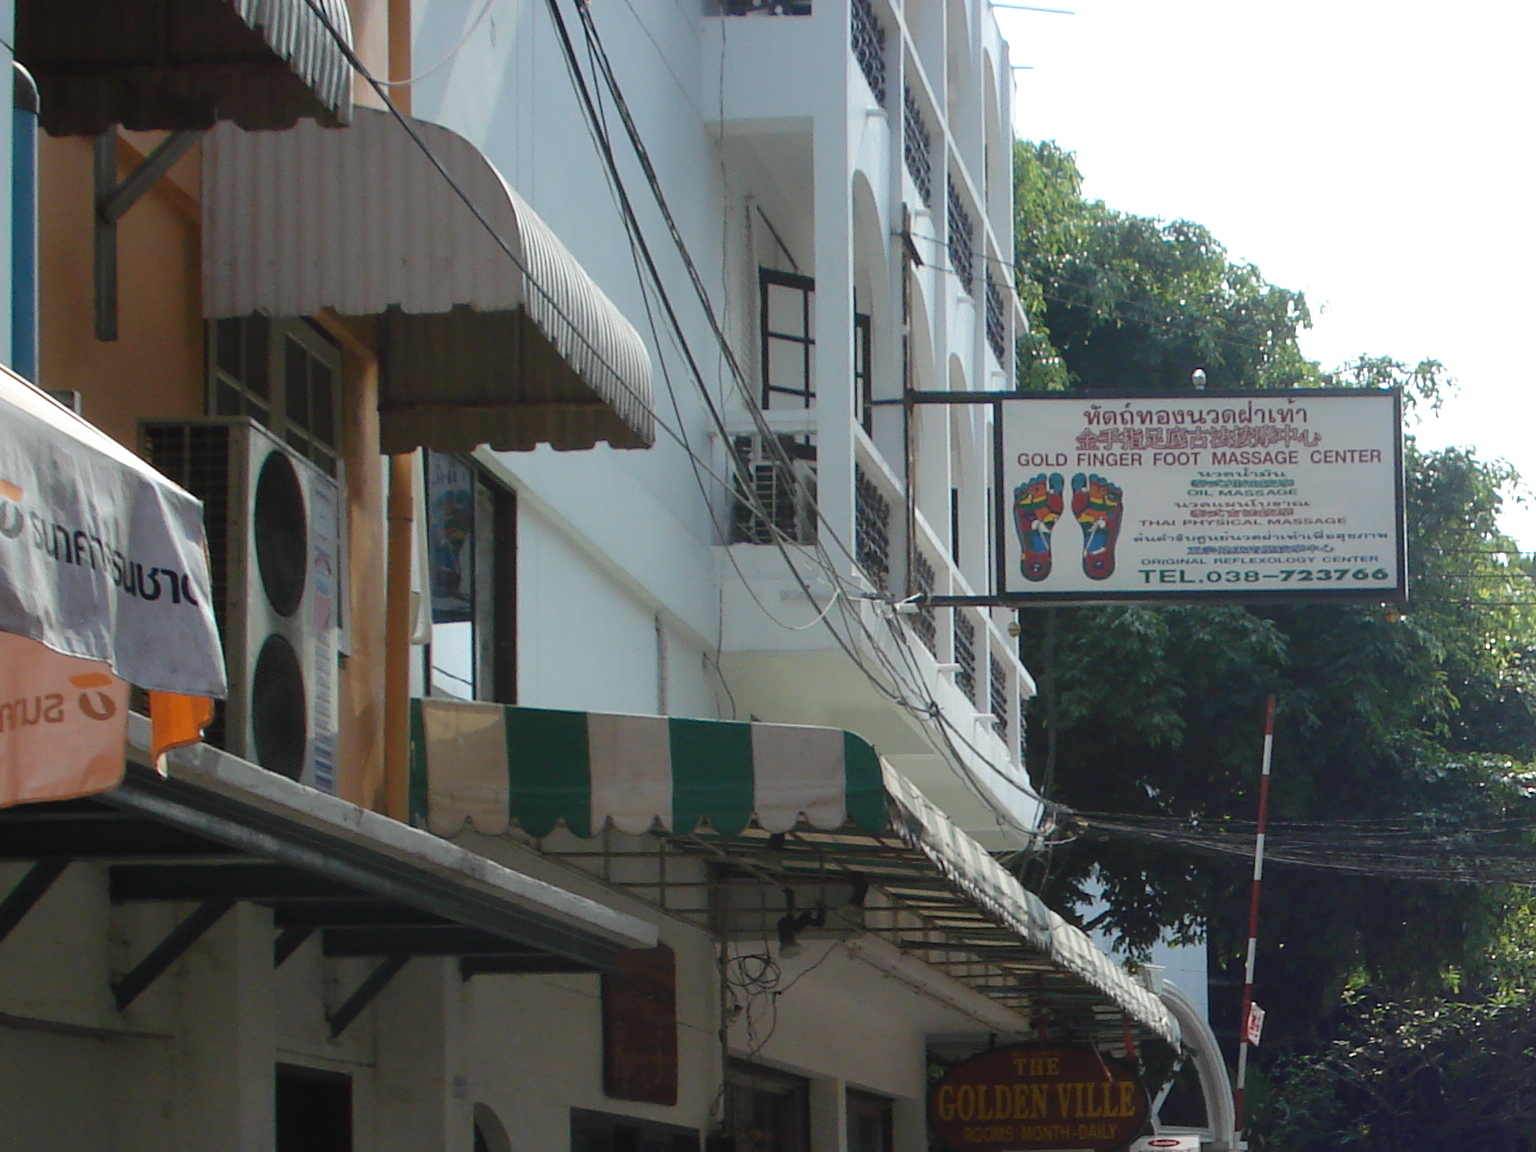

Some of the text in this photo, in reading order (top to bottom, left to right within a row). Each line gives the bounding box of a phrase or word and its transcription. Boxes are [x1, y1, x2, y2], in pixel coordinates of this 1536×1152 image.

[1017, 449, 1382, 467] GOLD FINGER FOOT MASSAGE CENTER
[1187, 488, 1298, 497] OIL MASSAGE
[1139, 517, 1348, 527] THAI PHYSICAL MASSAGE
[1140, 554, 1379, 566] ORIGINAL REFLEXOLOGY CENTER
[1013, 1056, 1060, 1077] THE
[937, 1080, 1137, 1122] GOLDEN VILLE
